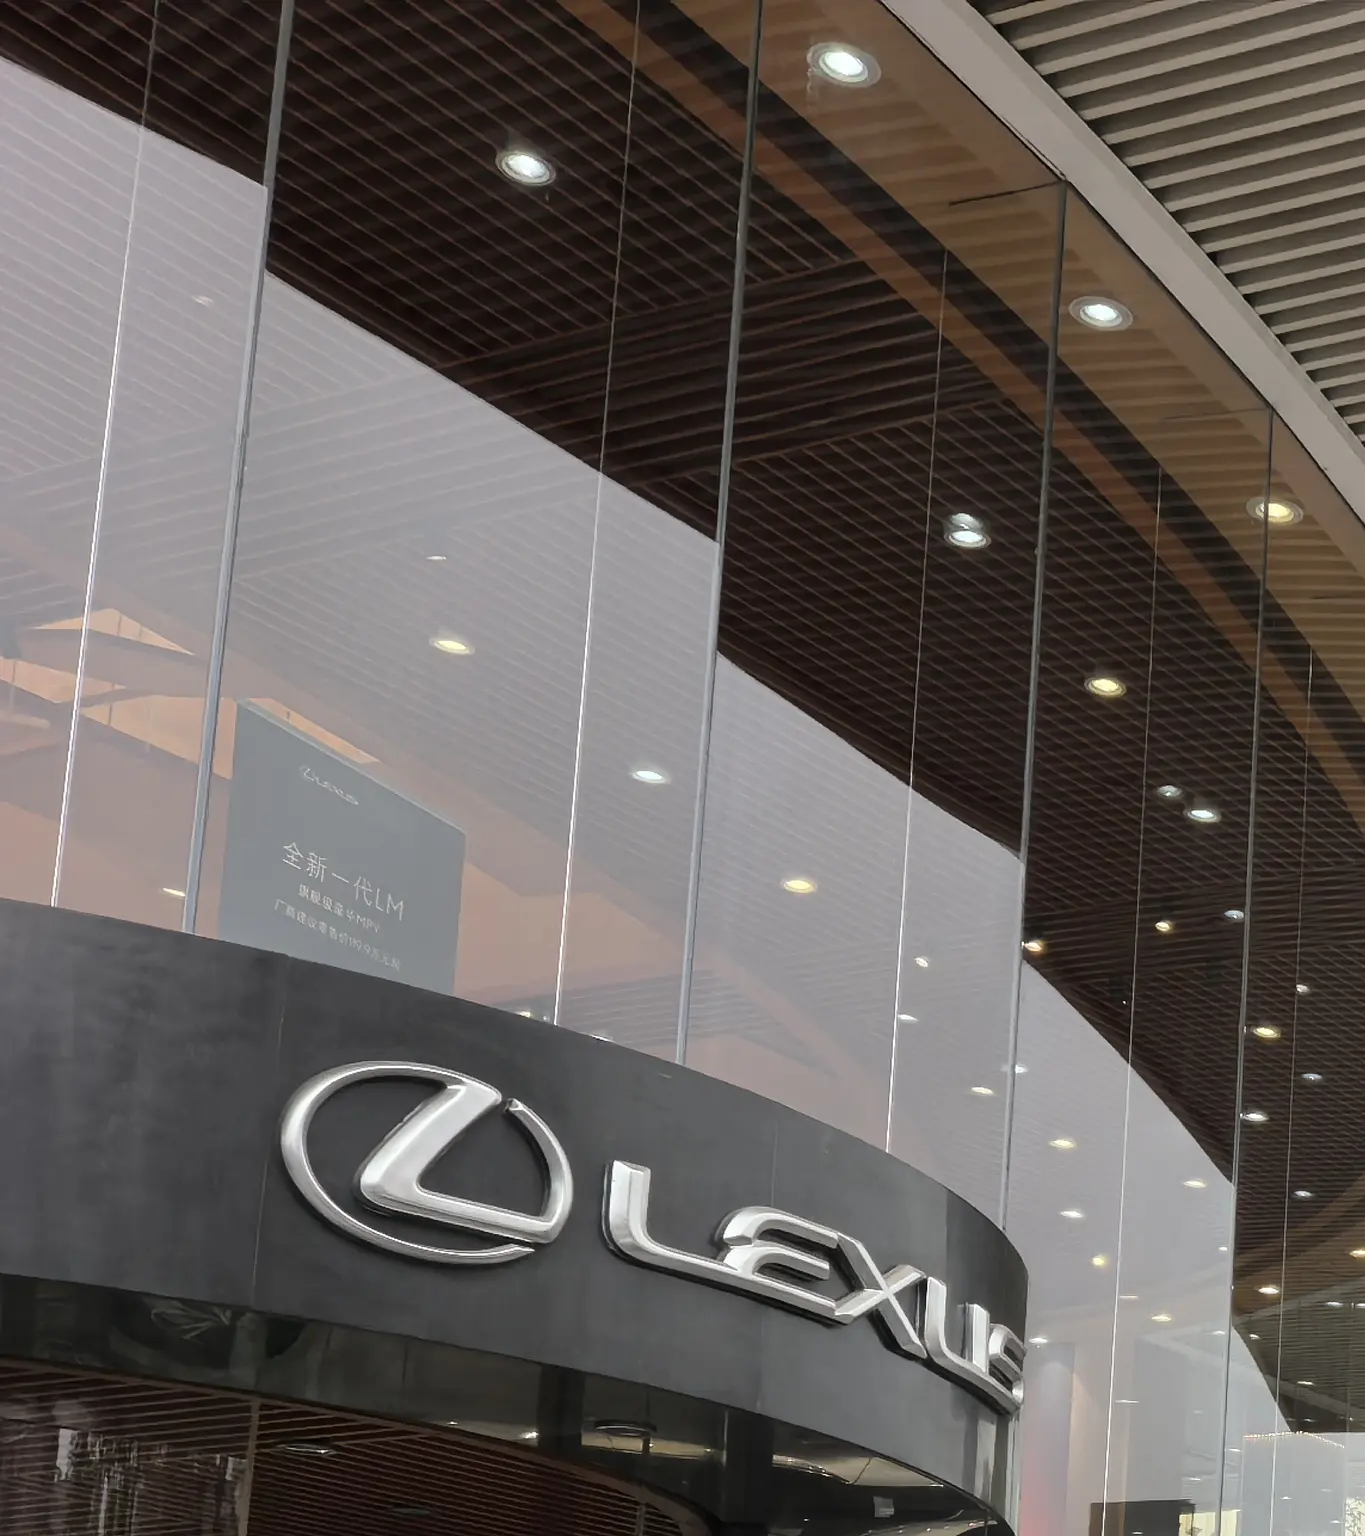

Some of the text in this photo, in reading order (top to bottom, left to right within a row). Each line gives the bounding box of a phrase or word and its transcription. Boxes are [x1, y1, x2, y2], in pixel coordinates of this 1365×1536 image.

[282, 842, 404, 921] 全新一代LM
[601, 1159, 1027, 1416] LEXUS
